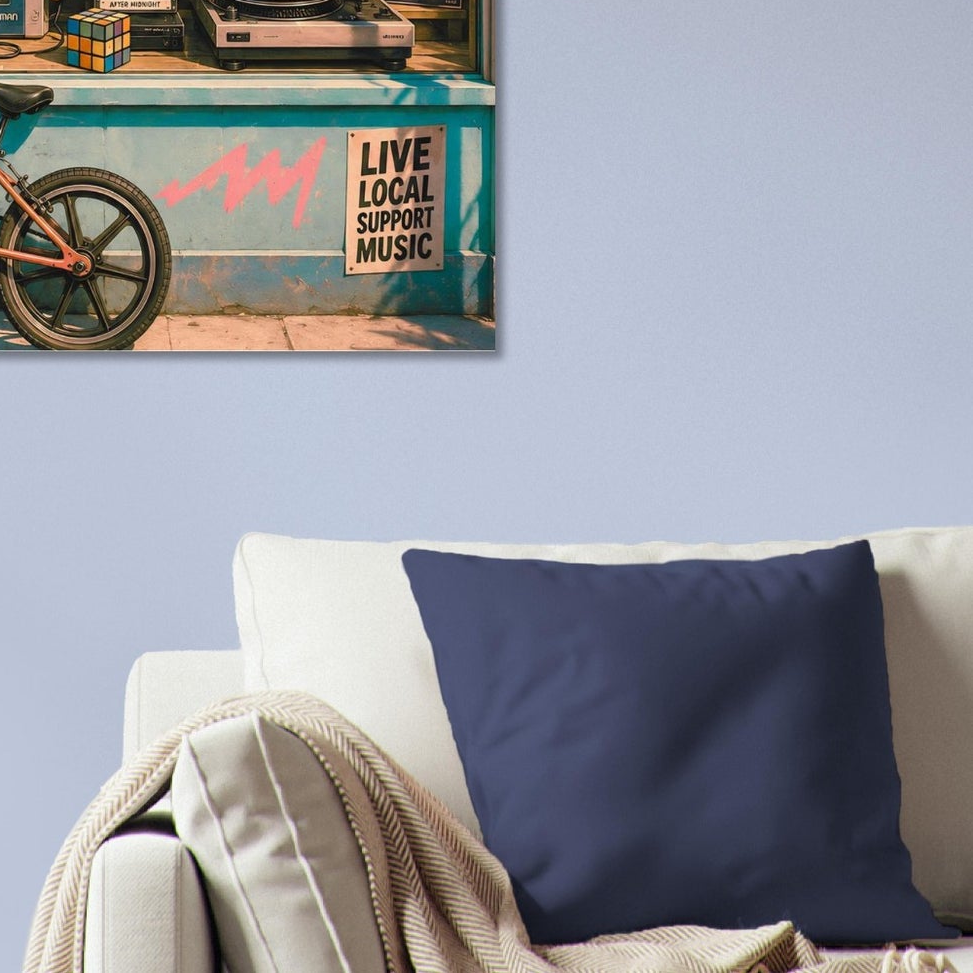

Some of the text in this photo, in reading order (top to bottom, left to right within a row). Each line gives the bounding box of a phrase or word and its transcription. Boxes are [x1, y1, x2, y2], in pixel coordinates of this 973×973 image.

[360, 137, 432, 176] LIVE
[358, 175, 434, 208] LOCAL
[357, 206, 434, 234] SUPPORT
[356, 232, 433, 264] MUSIC
